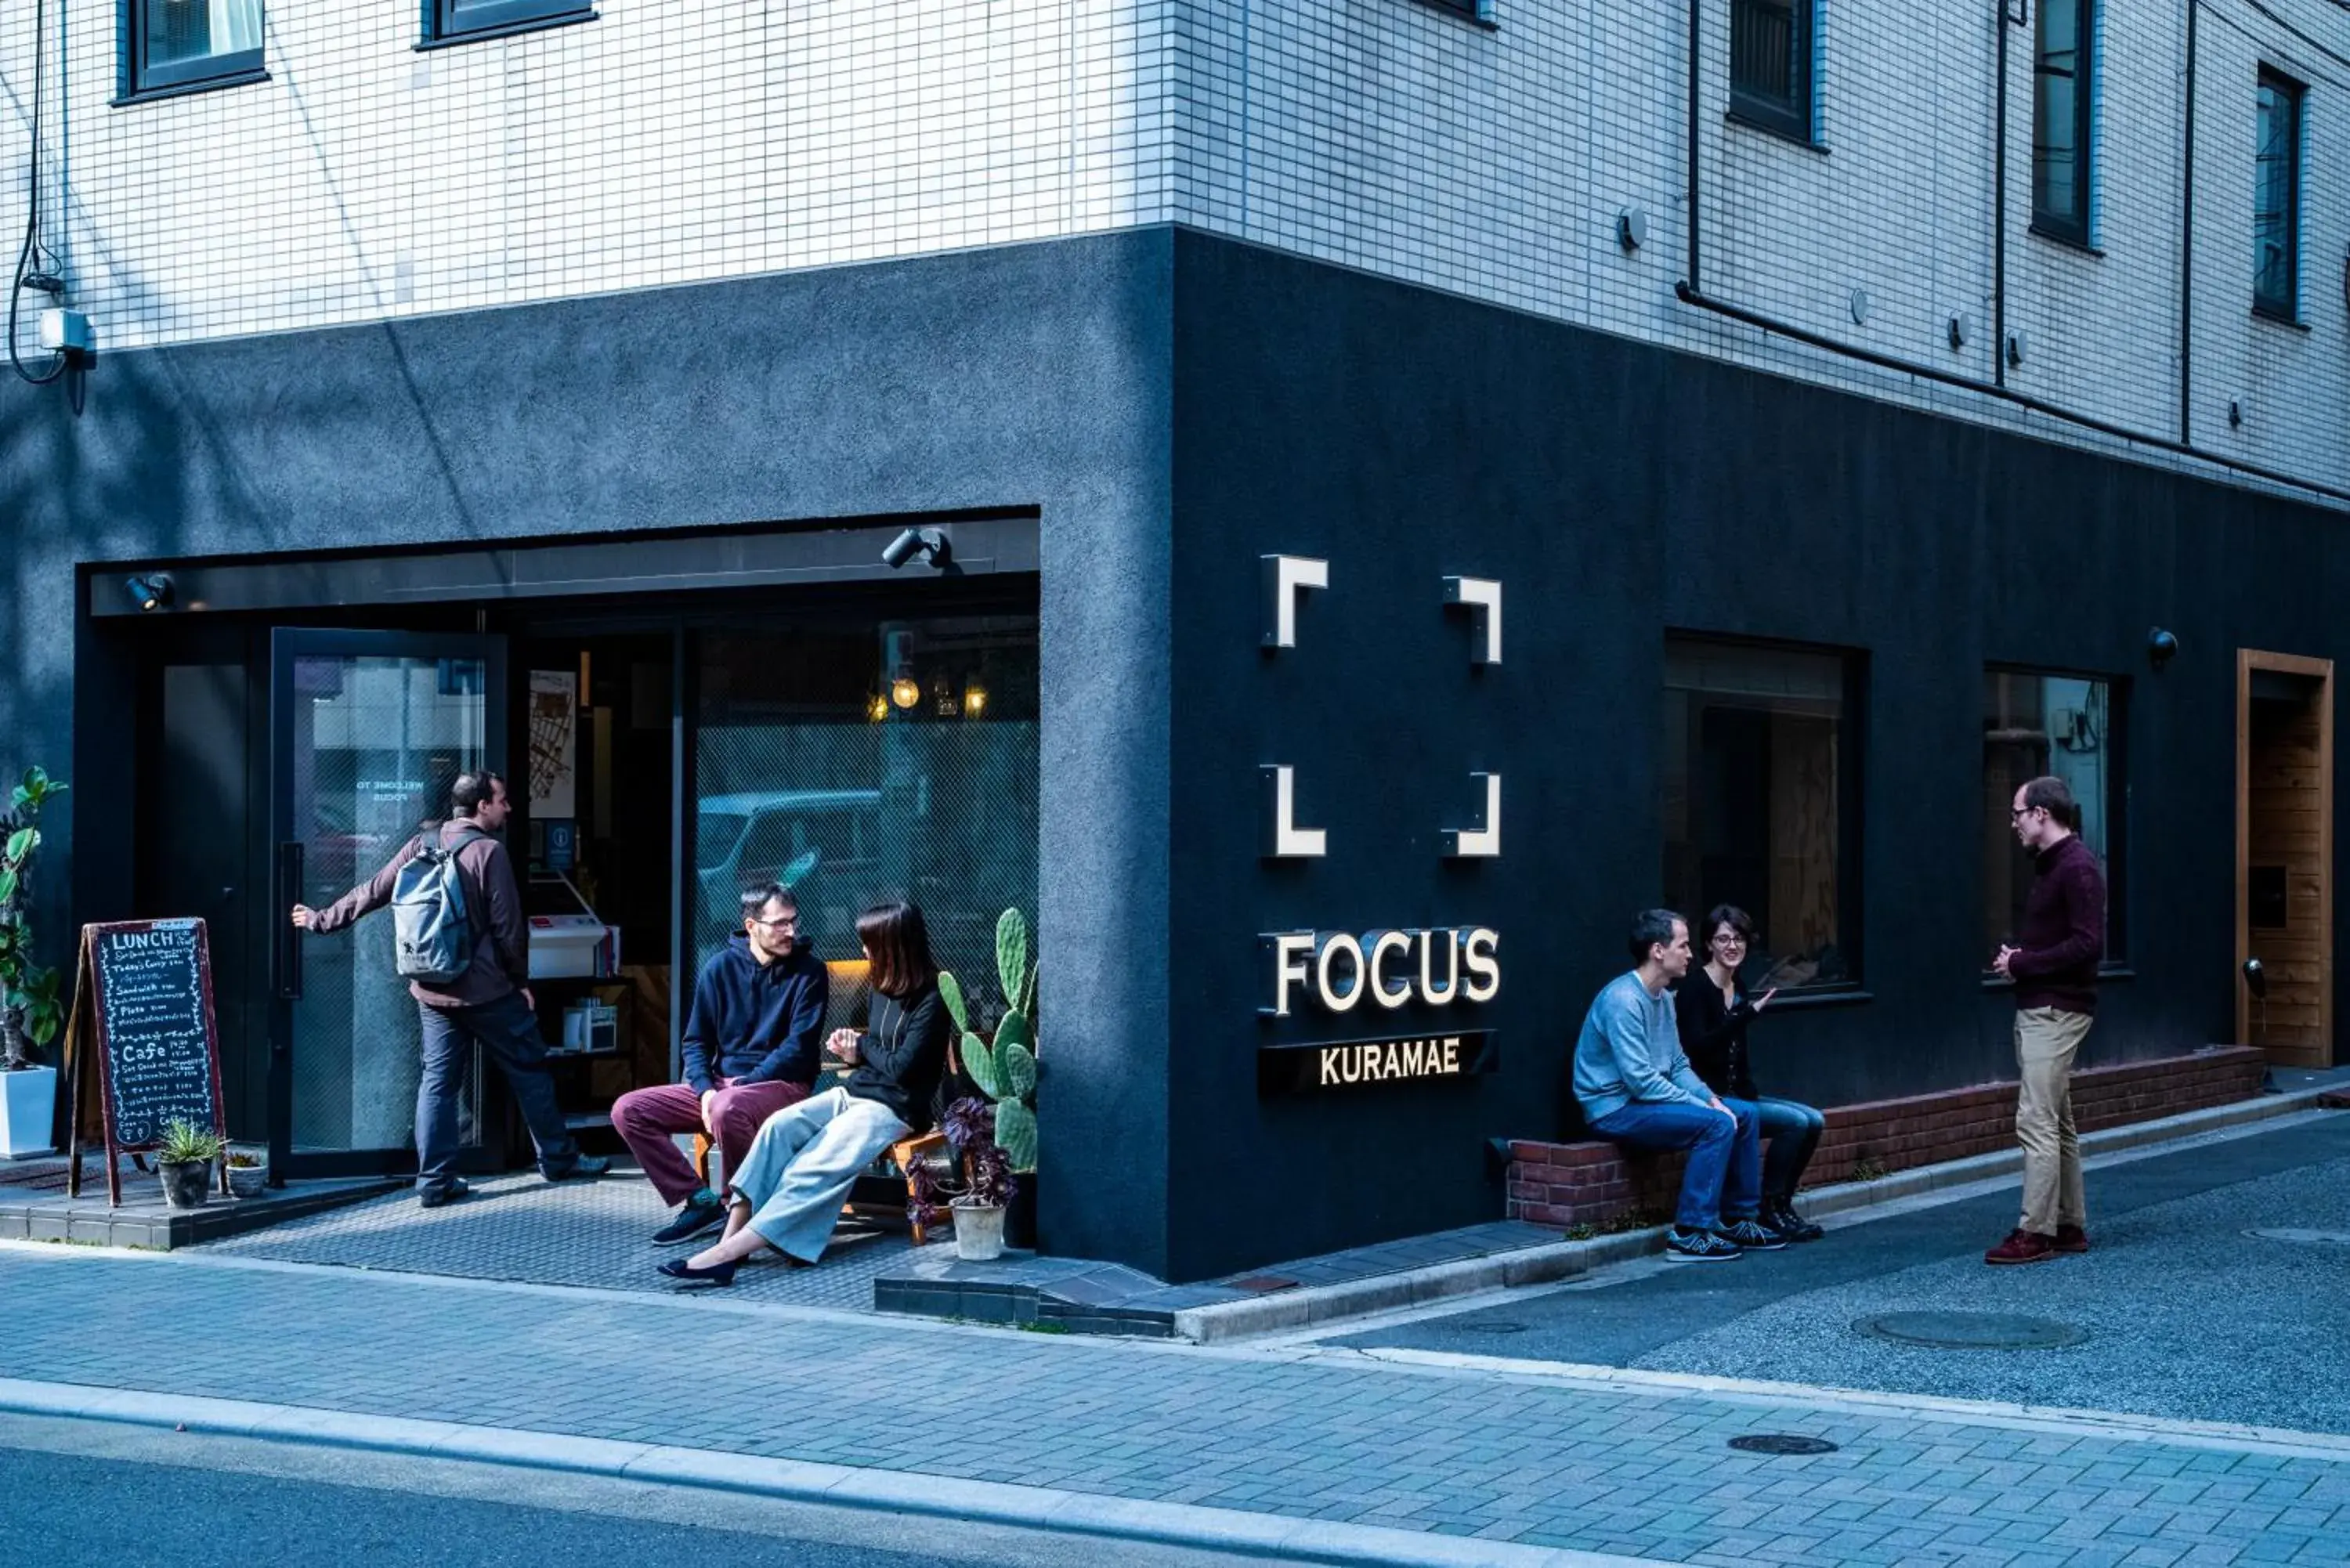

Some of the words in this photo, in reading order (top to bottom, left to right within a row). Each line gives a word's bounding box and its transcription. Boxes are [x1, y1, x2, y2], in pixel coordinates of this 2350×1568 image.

[112, 931, 173, 949] LUNCH
[1276, 929, 1499, 1016] FOCUS
[123, 1042, 165, 1062] Cafe
[1320, 1038, 1459, 1085] KURAMAE
